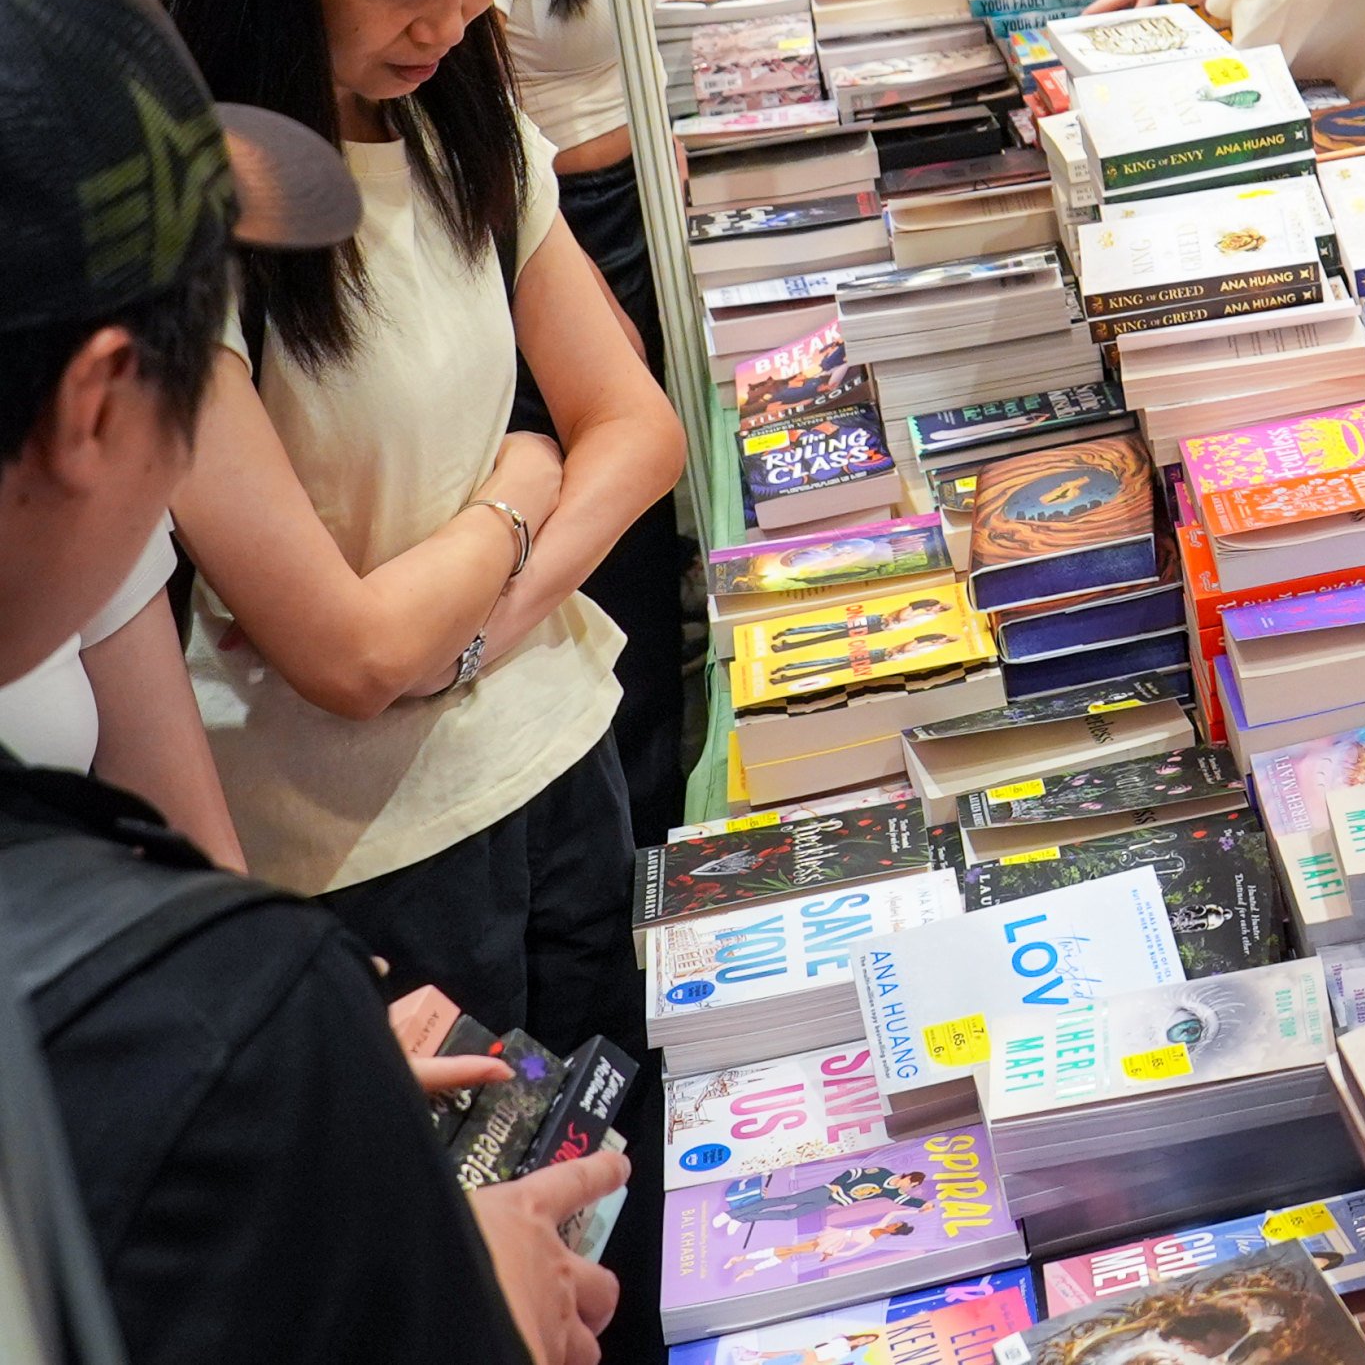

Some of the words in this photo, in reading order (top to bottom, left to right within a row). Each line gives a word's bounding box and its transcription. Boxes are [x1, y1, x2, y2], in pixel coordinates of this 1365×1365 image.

[1002, 18, 1033, 32] YOUR
[1124, 159, 1156, 174] KING
[1171, 150, 1203, 165] ENVY
[1215, 144, 1241, 157] ANA
[1243, 133, 1285, 151] HUANG
[1109, 295, 1143, 309] KING
[1159, 286, 1203, 301] GREED
[1220, 279, 1247, 292] ANA
[1249, 272, 1293, 287] HUANG
[1114, 320, 1147, 334] KING
[1163, 309, 1208, 326] GREED
[1224, 302, 1249, 315] ANA
[1252, 293, 1296, 309] HUANG
[755, 324, 841, 374] BREAK
[781, 358, 814, 379] ME
[749, 405, 805, 427] TILLIE
[815, 376, 862, 405] COLE
[761, 428, 870, 470] RULING
[800, 434, 825, 445] The
[768, 446, 870, 484] CLASS
[645, 849, 659, 881] LAUREN
[1297, 852, 1345, 900] MAFI
[645, 883, 658, 919] ROBERTS
[715, 915, 788, 984] YOU
[800, 893, 873, 977] SAVE
[870, 951, 899, 997] ANA
[883, 1001, 918, 1080] HUANG
[1006, 1036, 1044, 1092] MAFI
[730, 1084, 806, 1139] US
[821, 1050, 883, 1143] SAVE
[924, 1135, 993, 1237] SPIRAL
[681, 1208, 695, 1227] BAL
[681, 1229, 695, 1277] KHABRA
